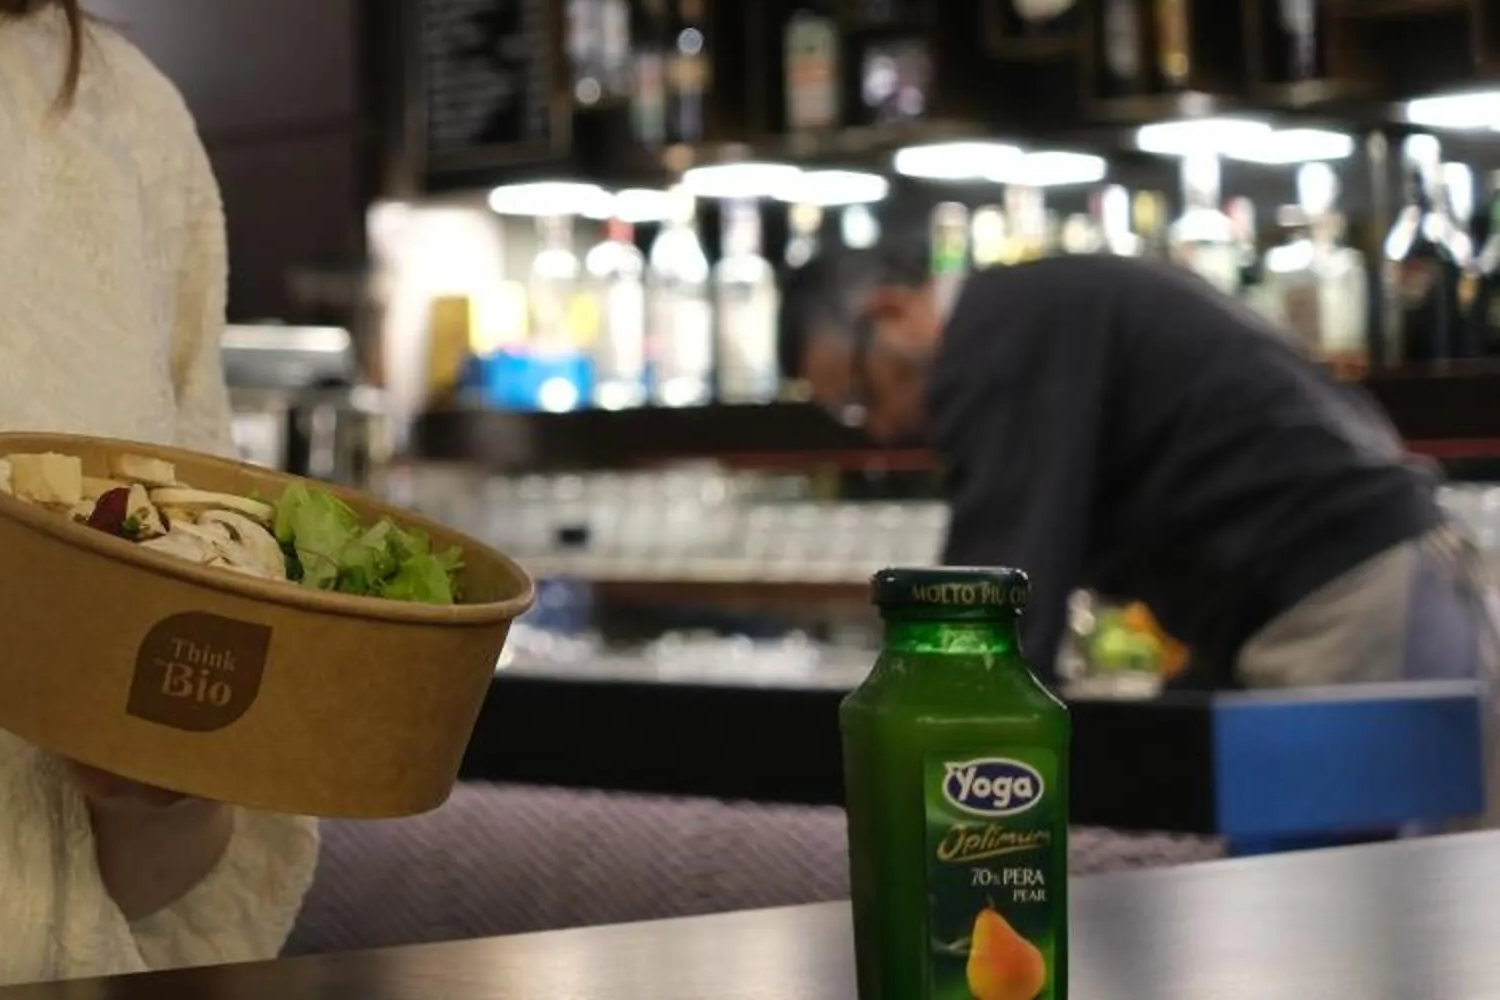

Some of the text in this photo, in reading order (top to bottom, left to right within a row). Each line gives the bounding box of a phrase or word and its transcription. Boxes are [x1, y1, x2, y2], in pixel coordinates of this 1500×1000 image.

[912, 583, 975, 604] MOLTO
[171, 637, 237, 671] Think
[159, 661, 232, 706] Bio
[955, 766, 1033, 808] Yoga
[1003, 867, 1045, 886] PERA
[1013, 889, 1046, 902] PEAR
